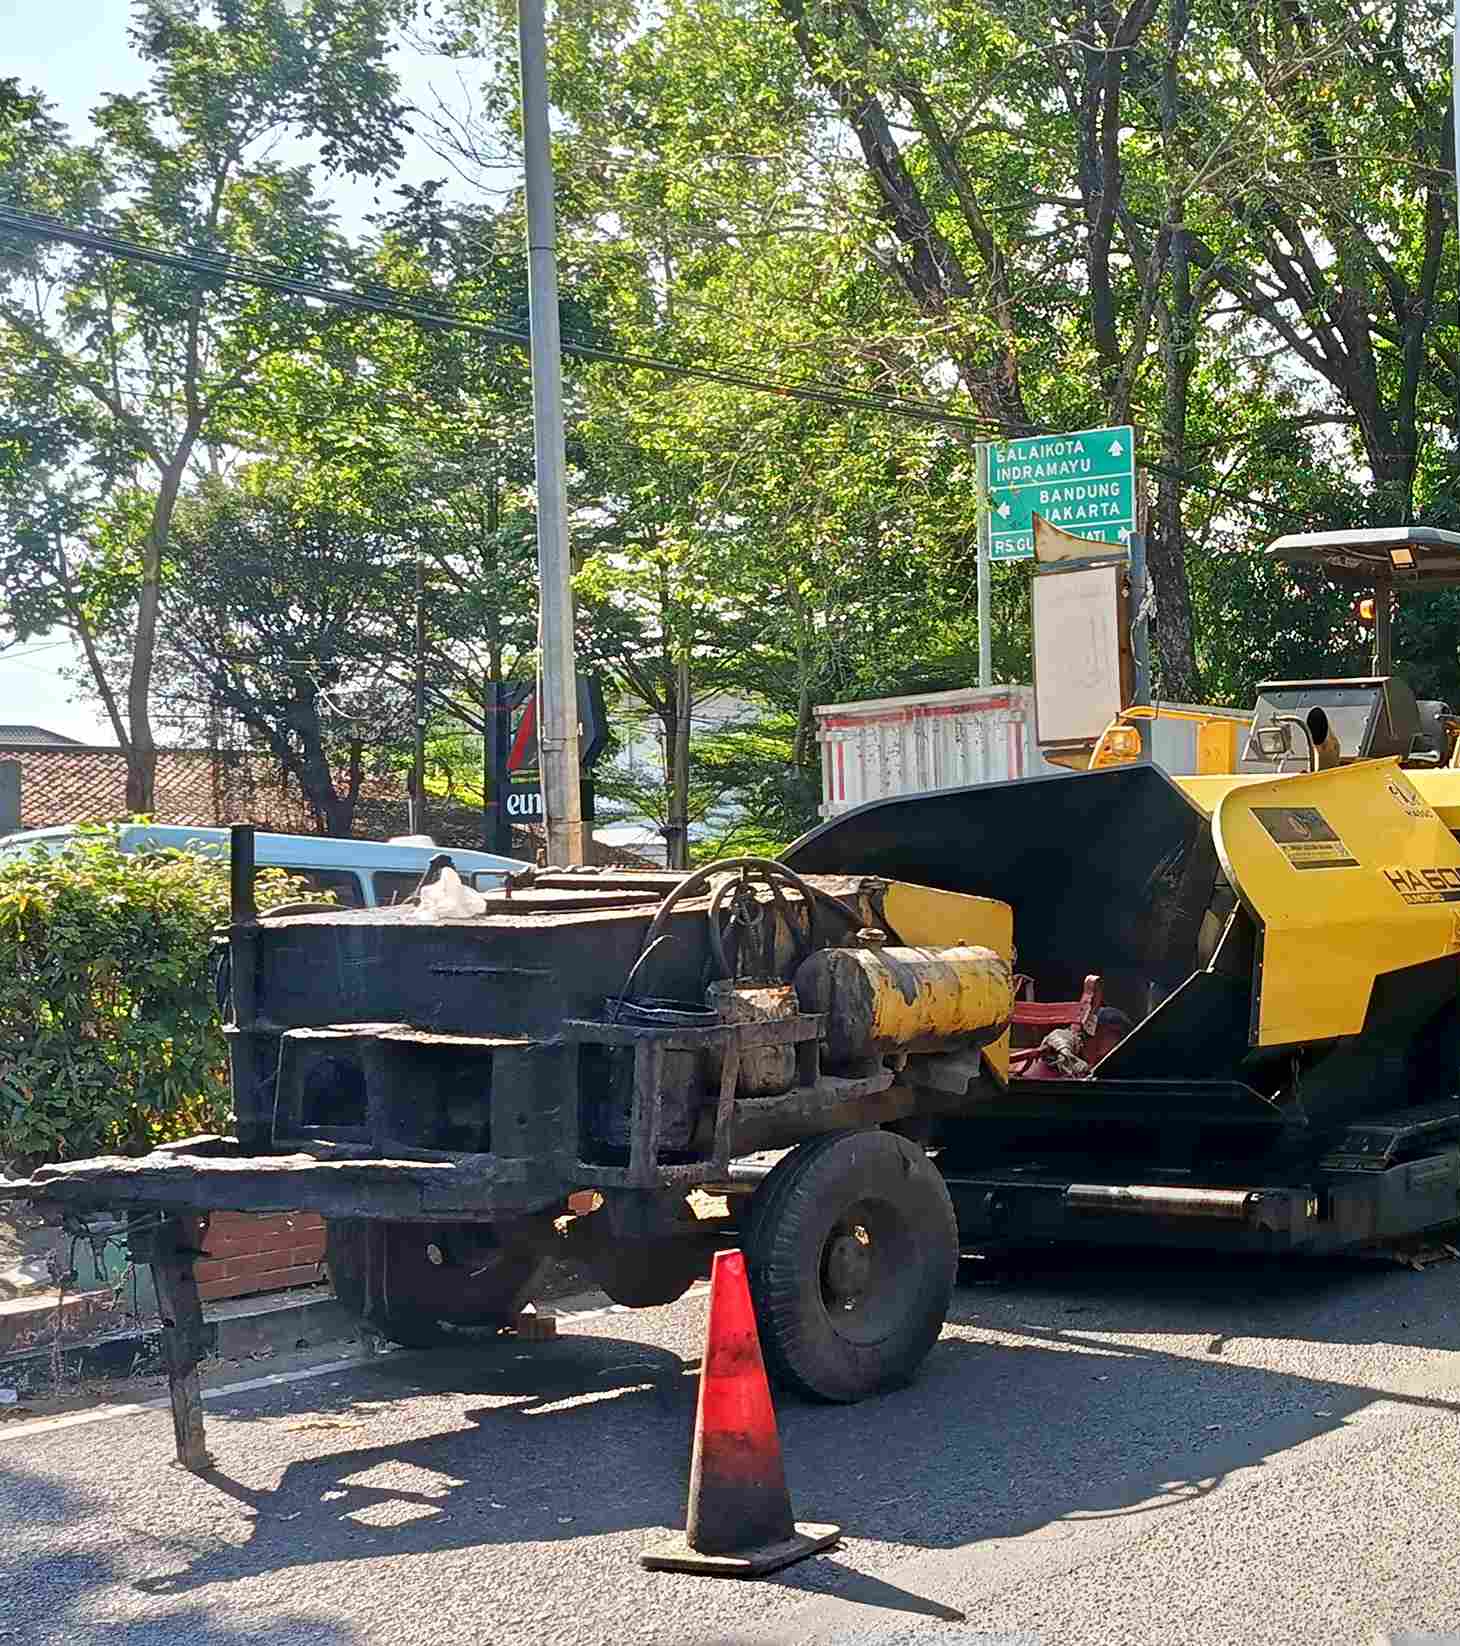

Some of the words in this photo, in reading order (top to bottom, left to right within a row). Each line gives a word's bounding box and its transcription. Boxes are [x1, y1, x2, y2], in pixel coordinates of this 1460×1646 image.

[996, 440, 1085, 464] BALAIKOTA
[996, 458, 1091, 481] INDRAMAYU
[1039, 482, 1120, 504] BANDUNG
[1043, 502, 1120, 522] JAKARTA
[995, 537, 1034, 554] RS.GU
[506, 793, 543, 815] eun
